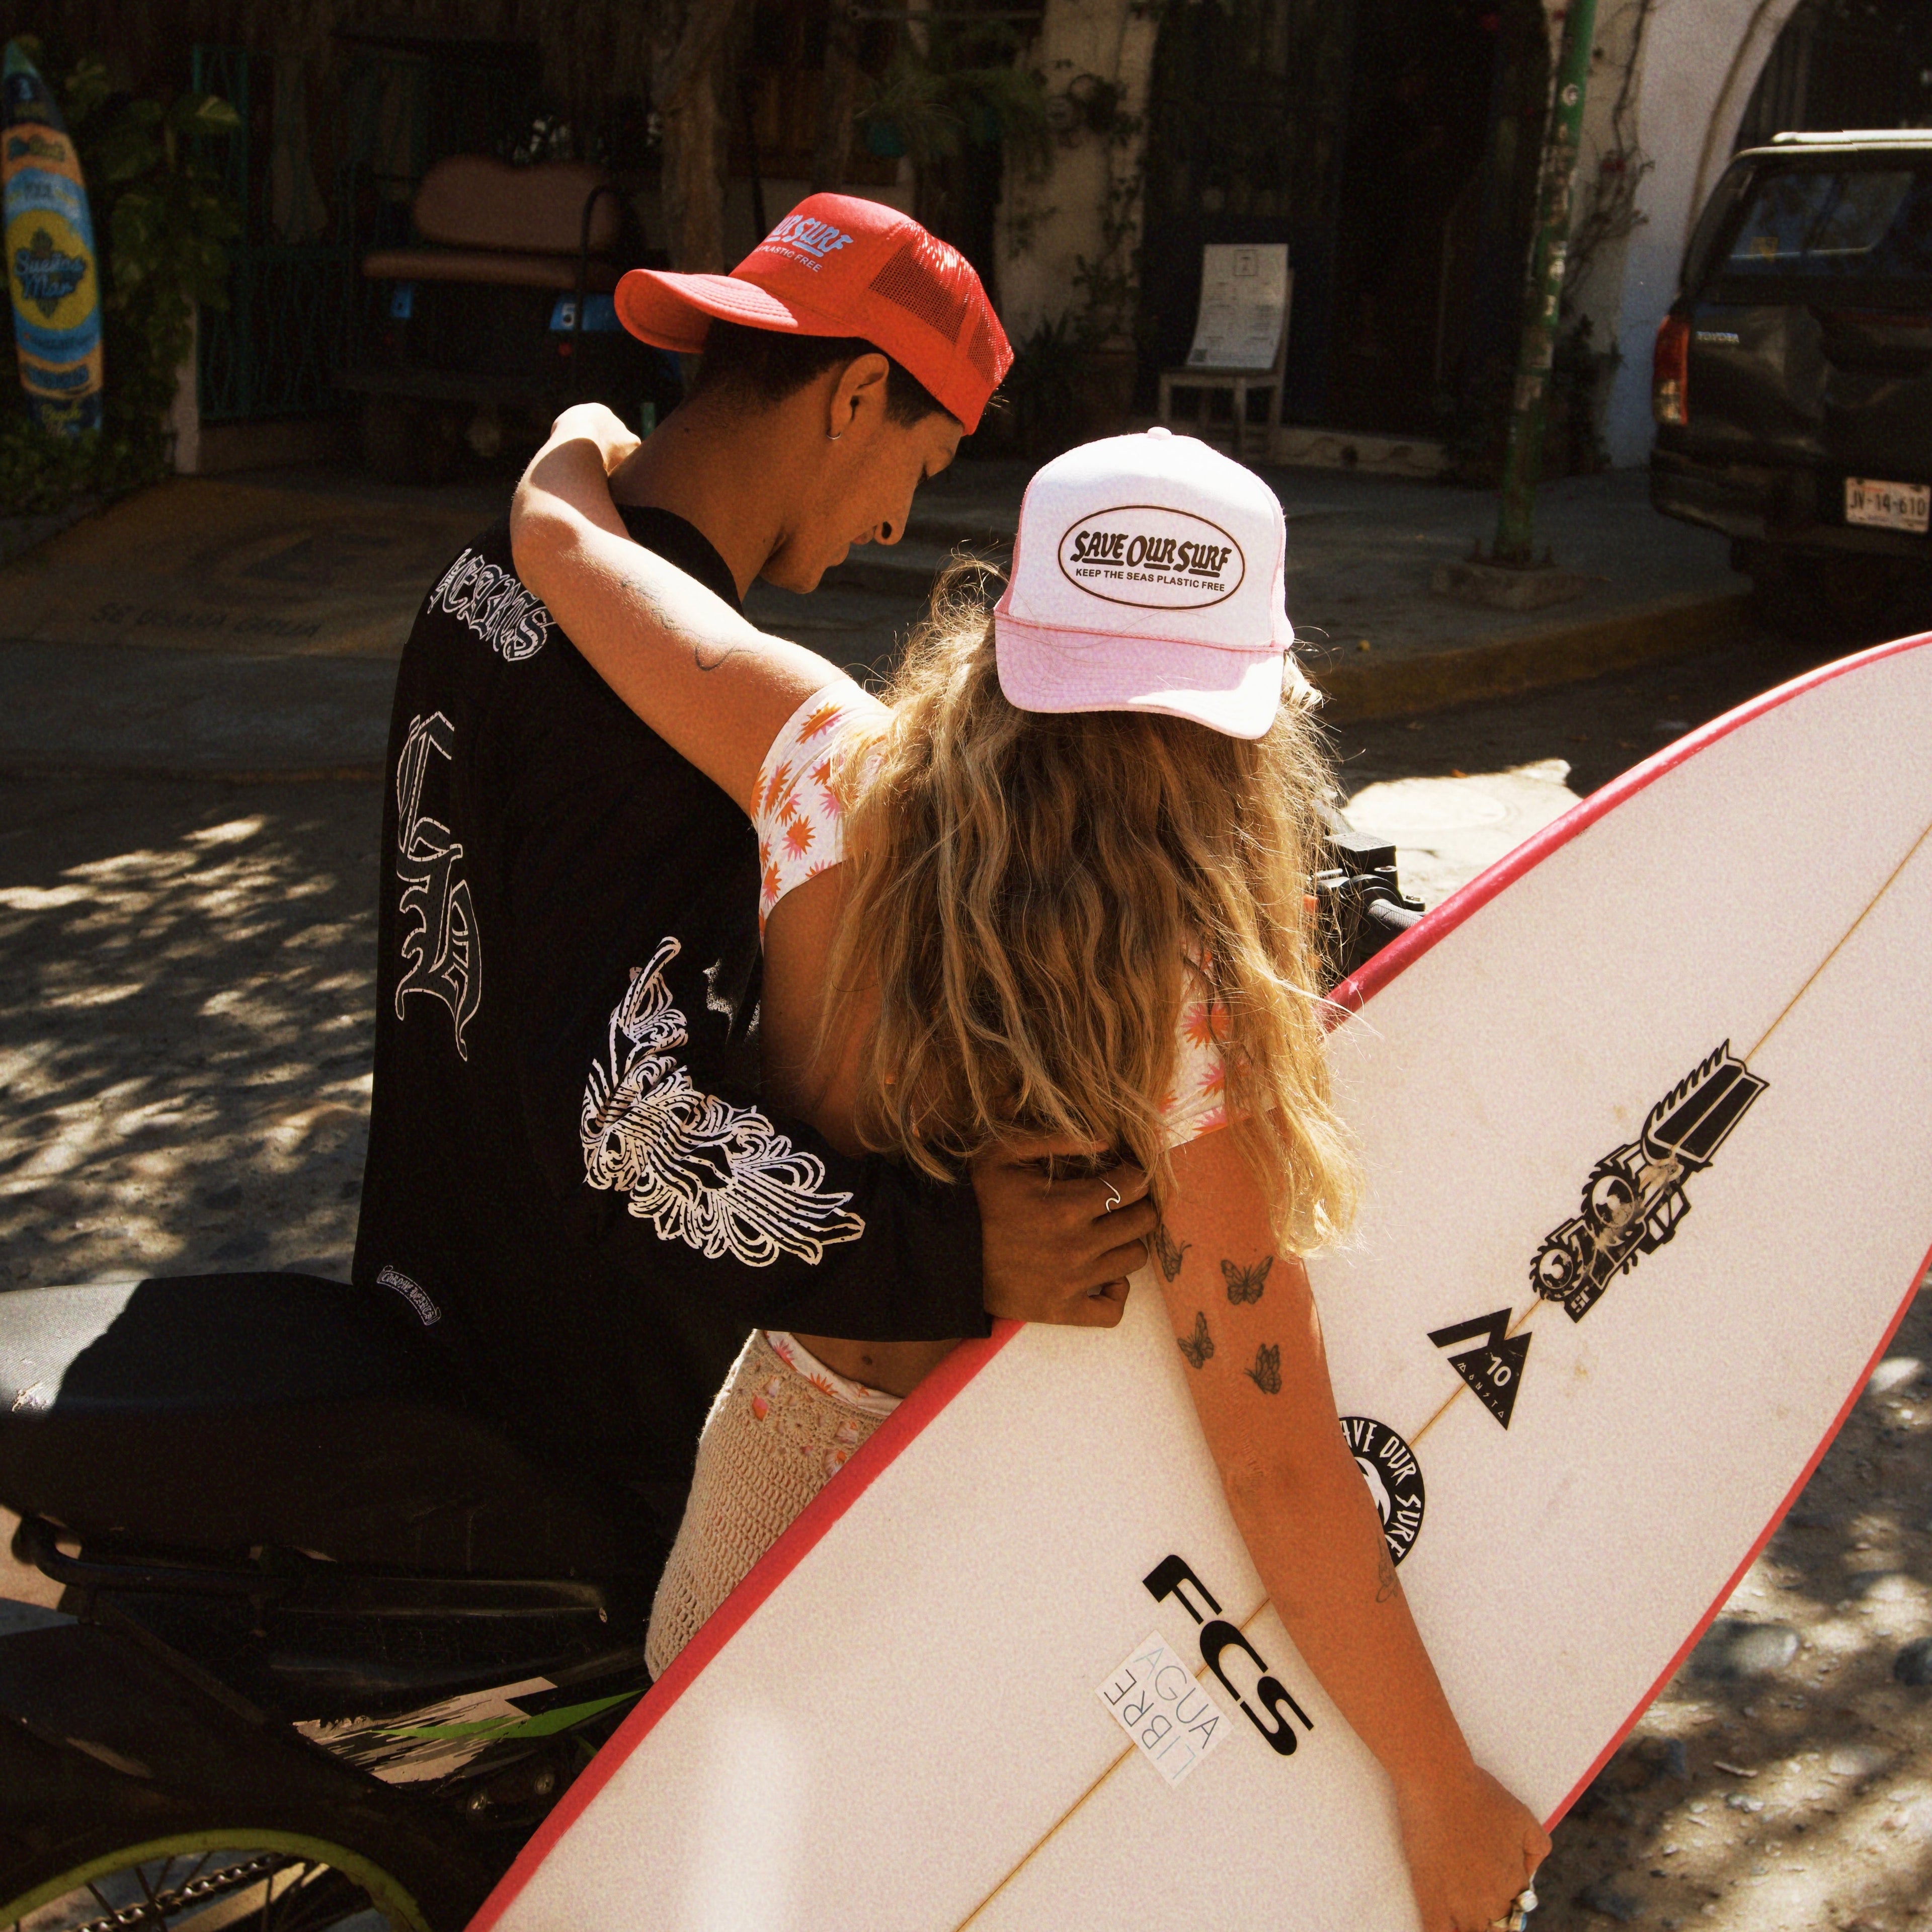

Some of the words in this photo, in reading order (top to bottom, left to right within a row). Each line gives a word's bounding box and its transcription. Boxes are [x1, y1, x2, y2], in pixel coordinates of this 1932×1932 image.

[772, 215, 803, 235] UR
[781, 217, 854, 253] SURF
[794, 254, 823, 272] FREE
[1070, 530, 1129, 562] SAVE
[1126, 535, 1177, 567] OUR
[1173, 541, 1232, 572] SURF
[1076, 568, 1101, 577] KEEP
[1104, 570, 1124, 579] THE
[1126, 572, 1154, 582] SEAS
[1157, 575, 1199, 588] PLASTIC
[1201, 581, 1225, 592] FREE
[1487, 1356, 1511, 1386] 10
[1339, 1420, 1378, 1452] AVE
[1379, 1436, 1417, 1486] OUR
[1385, 1494, 1421, 1558] SURF
[1143, 1554, 1315, 1756] FCS
[1133, 1647, 1220, 1749] AGUA
[1104, 1669, 1196, 1780] LIBRE
